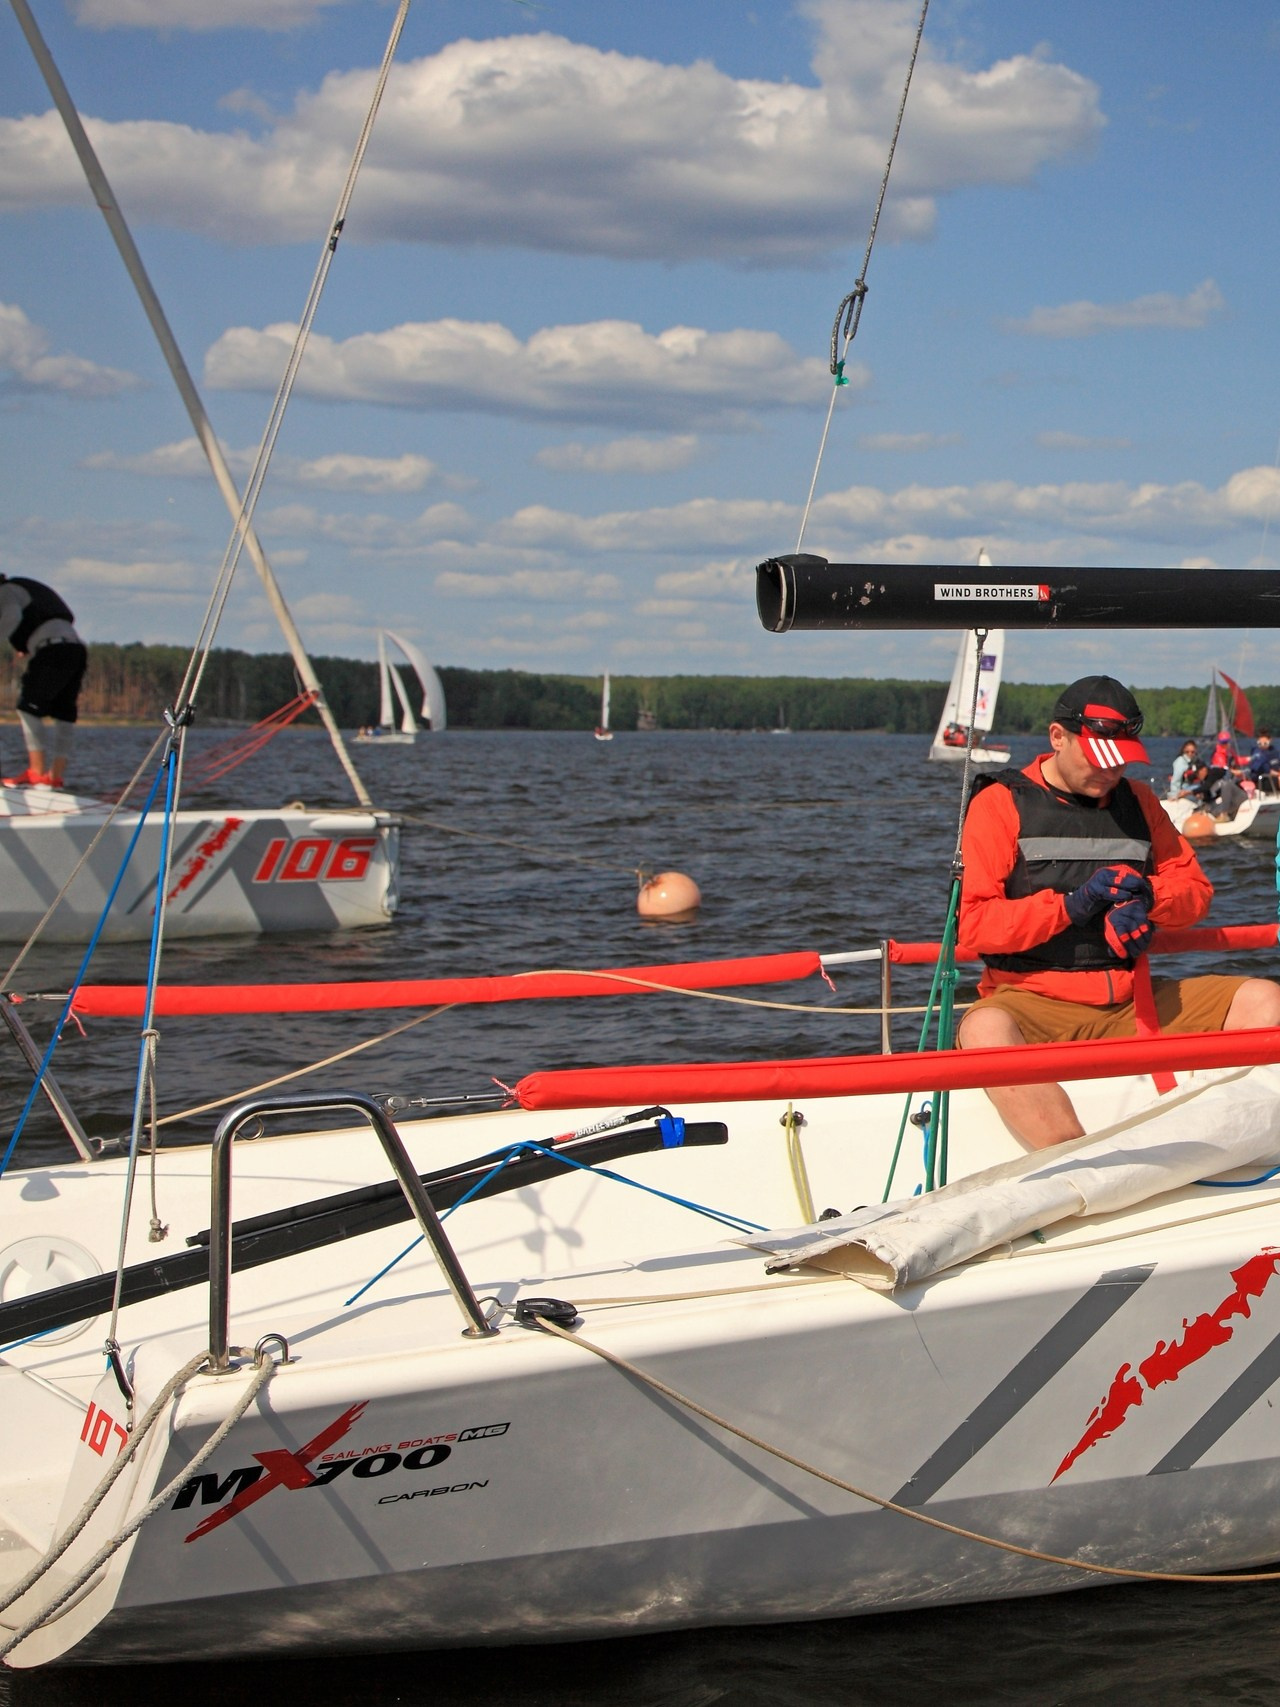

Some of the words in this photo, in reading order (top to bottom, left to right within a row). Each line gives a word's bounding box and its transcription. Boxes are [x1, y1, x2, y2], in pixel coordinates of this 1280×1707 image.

[940, 588, 971, 598] WIND
[975, 588, 1034, 598] BROTHERS
[252, 837, 377, 883] 106
[459, 1423, 508, 1441] MG
[321, 1444, 392, 1463] SAILING
[397, 1433, 458, 1450] BOATS
[377, 1479, 490, 1505] CARBON
